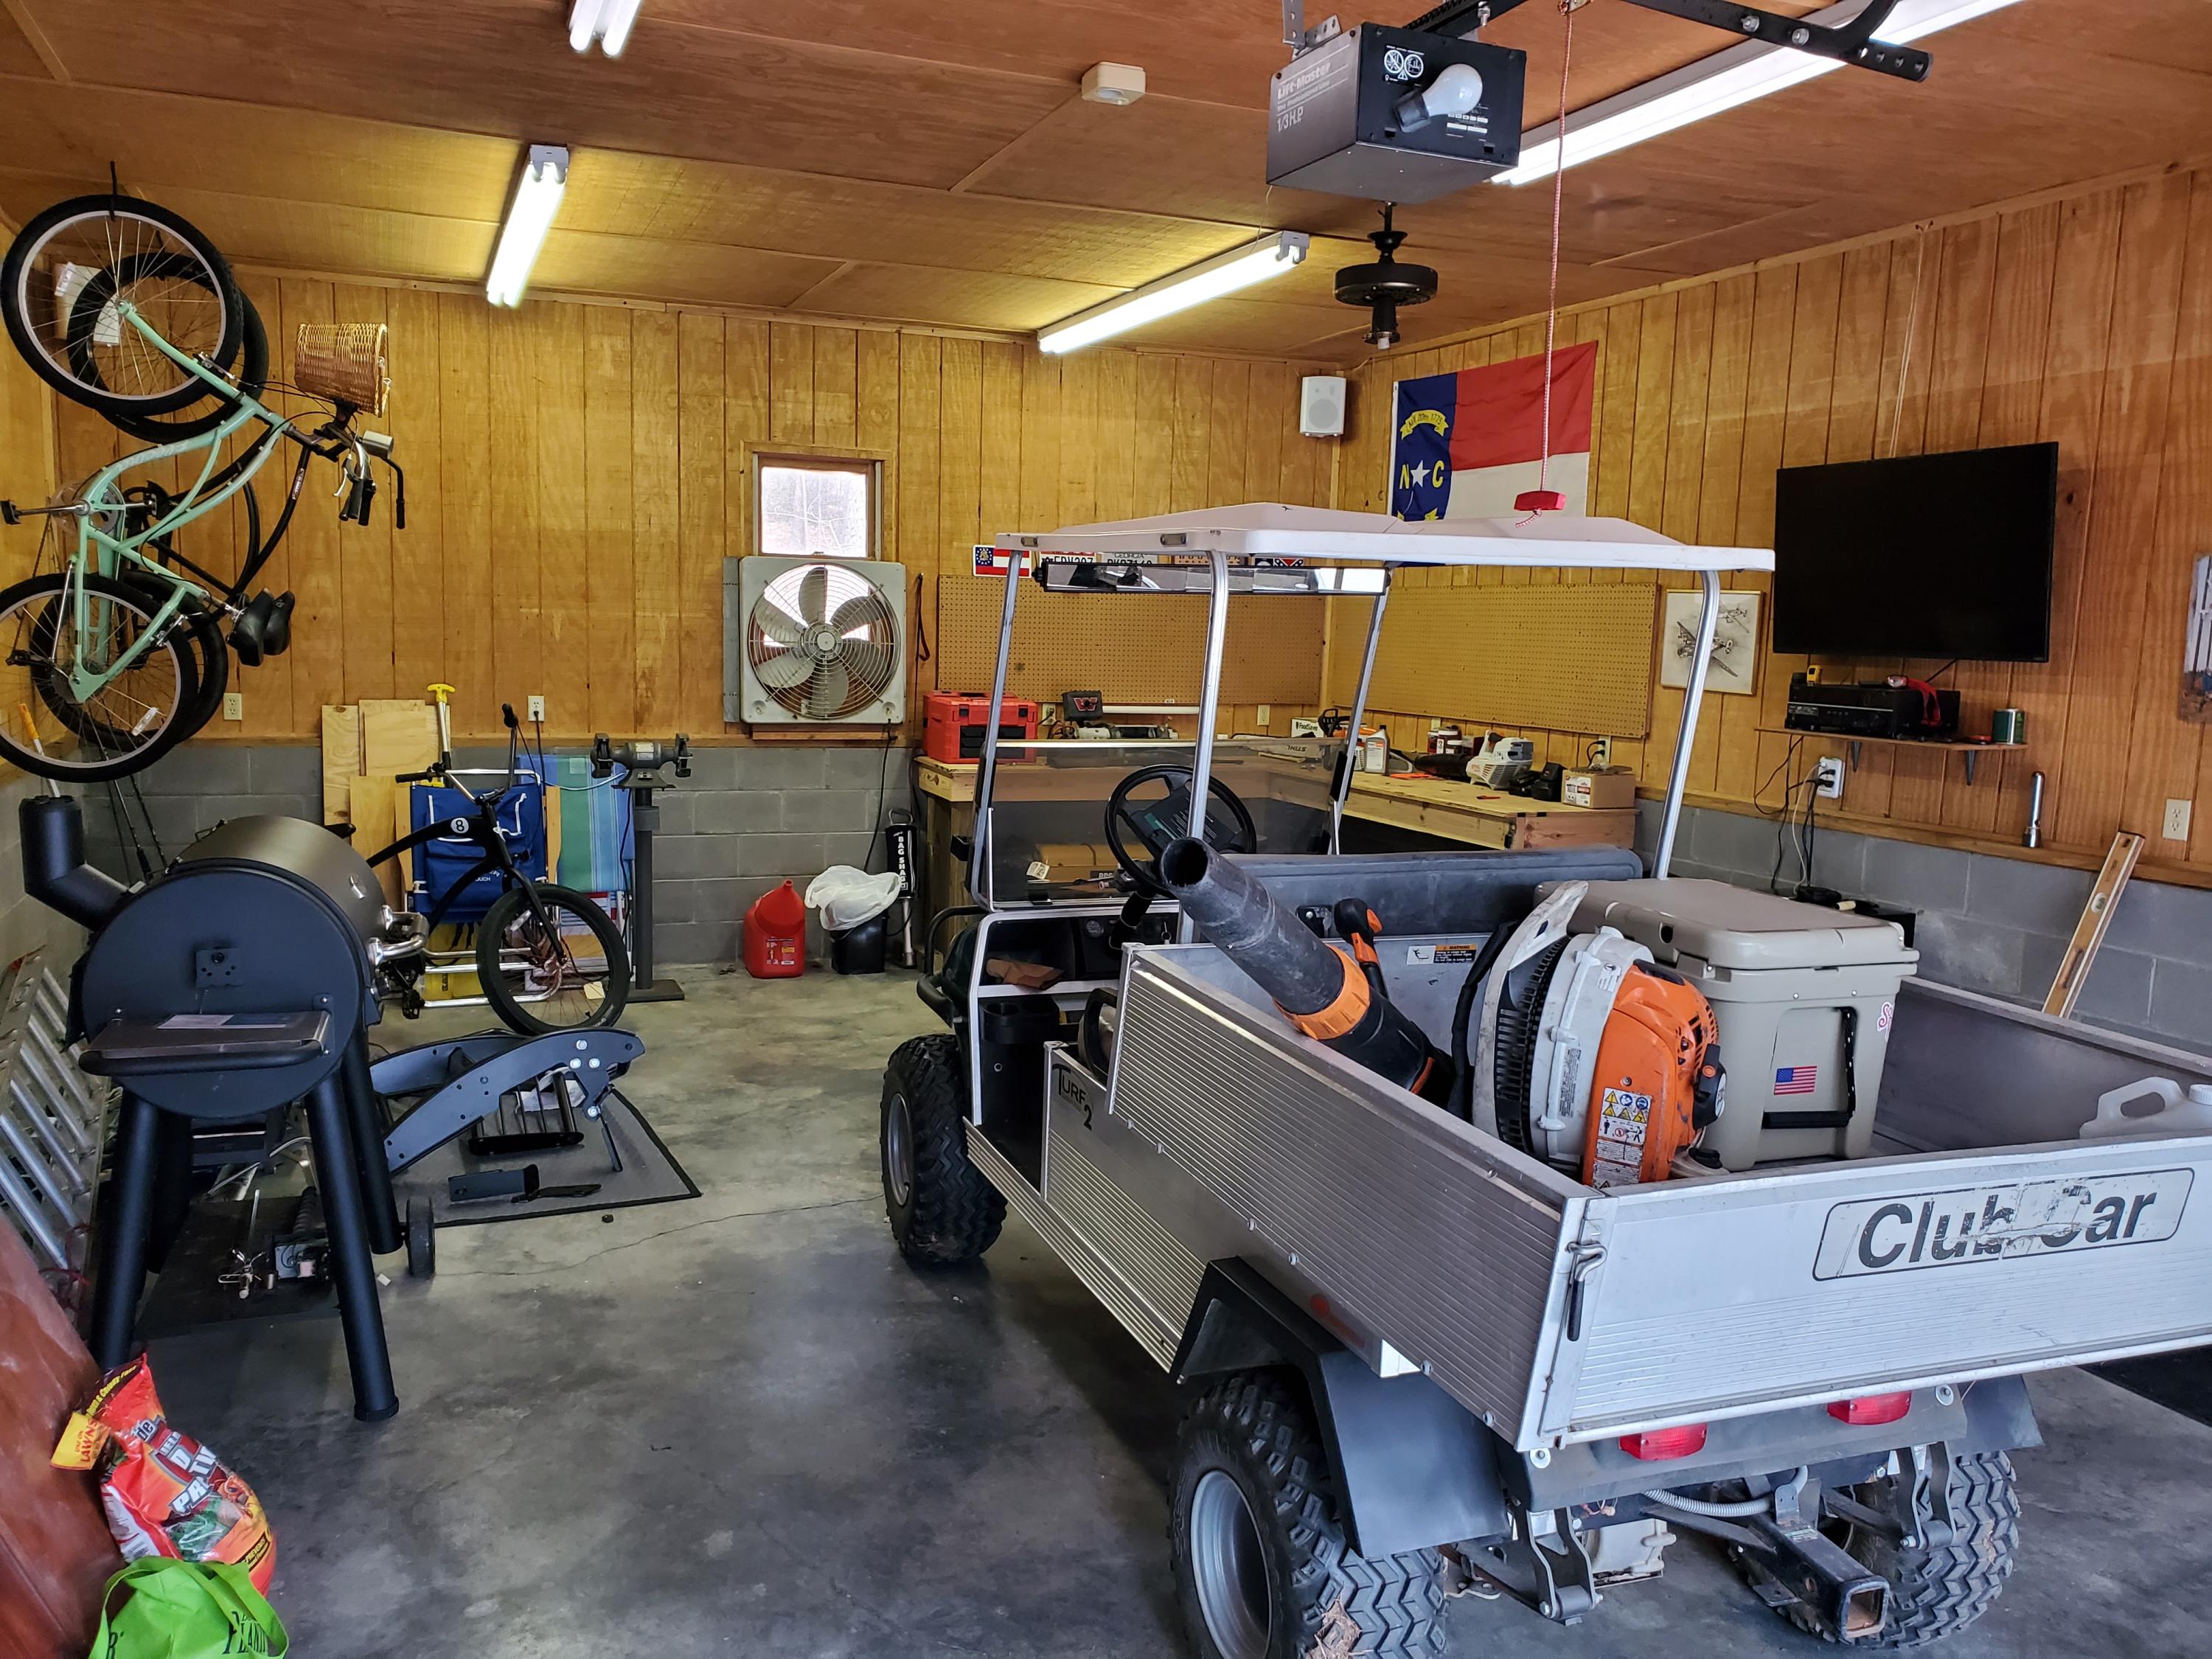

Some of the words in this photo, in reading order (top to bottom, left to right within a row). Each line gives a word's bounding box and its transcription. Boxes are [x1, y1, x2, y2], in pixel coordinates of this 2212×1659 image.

[1399, 464, 1410, 490] N
[1432, 460, 1444, 488] C
[455, 819, 465, 832] 8
[1051, 1063, 1086, 1105] TURF
[1083, 1104, 1093, 1131] 2
[1857, 1194, 2016, 1269] Club
[80, 1419, 99, 1463] LAWNS
